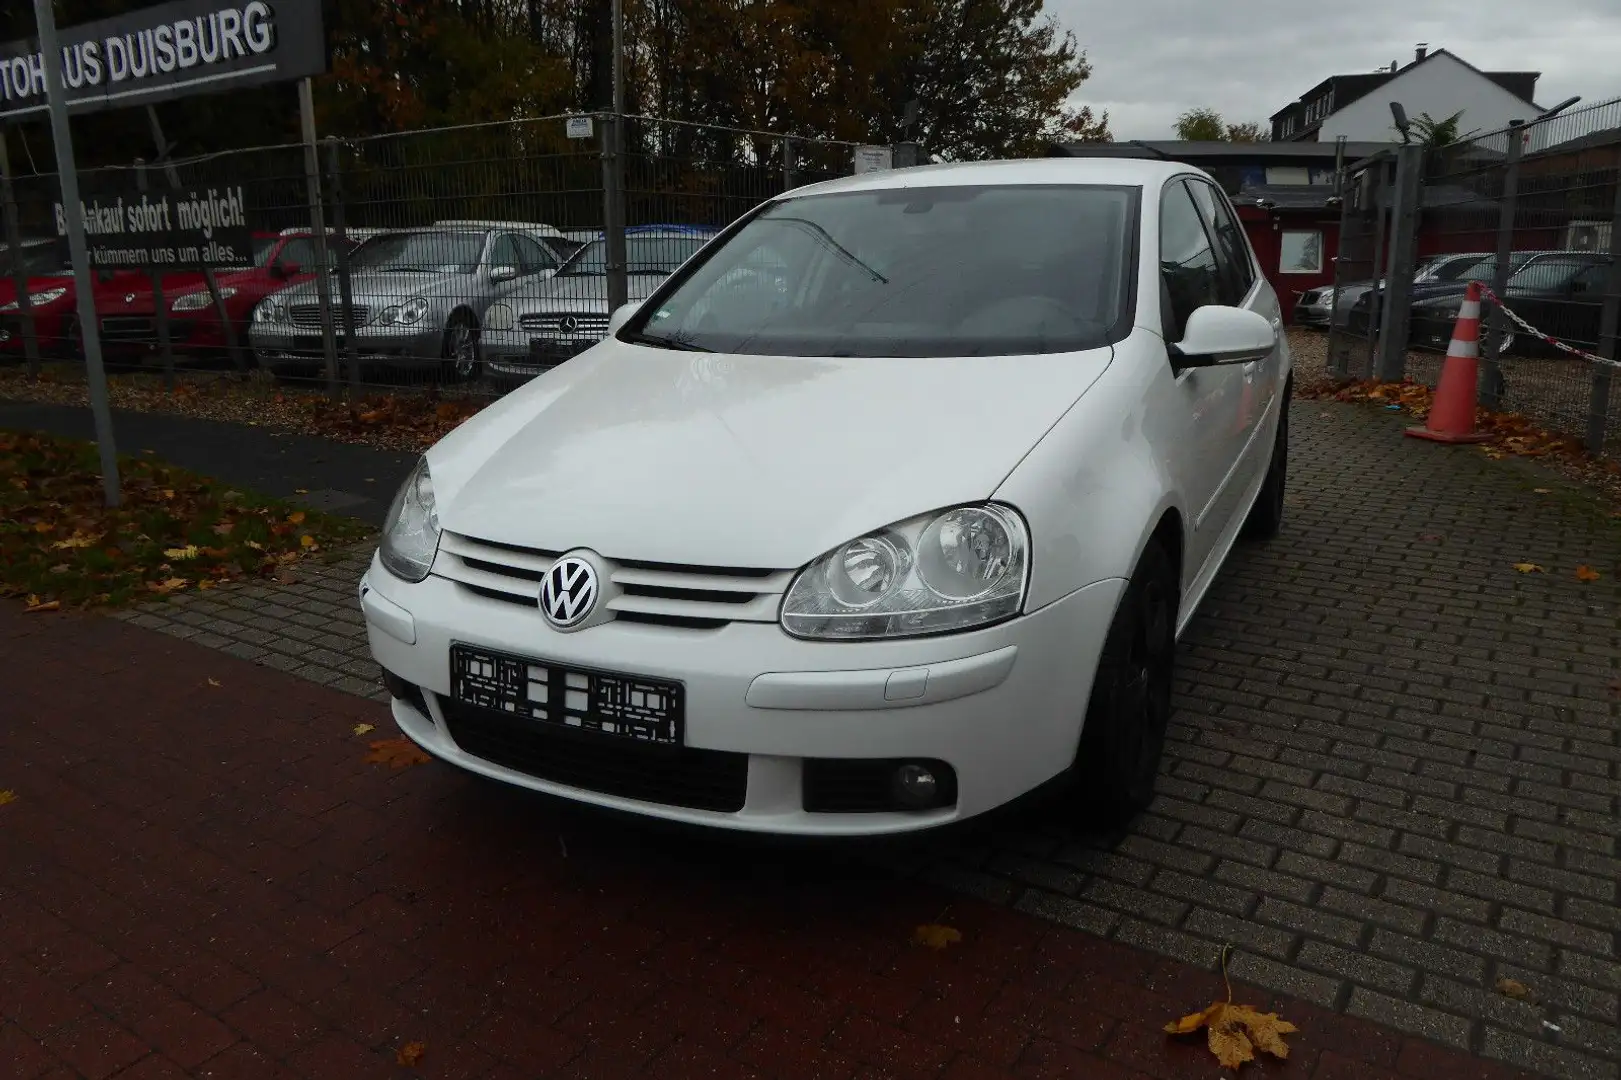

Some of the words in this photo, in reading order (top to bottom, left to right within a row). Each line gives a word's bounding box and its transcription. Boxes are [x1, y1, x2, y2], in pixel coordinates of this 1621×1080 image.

[0, 41, 101, 100] TOHUS
[106, 1, 272, 81] DUISBURG
[127, 194, 172, 233] sofort
[176, 186, 246, 239] möglich!
[93, 245, 149, 265] kümmern
[151, 248, 175, 263] uns
[178, 247, 200, 262] um
[202, 241, 248, 262] alles...
[542, 558, 597, 621] VW
